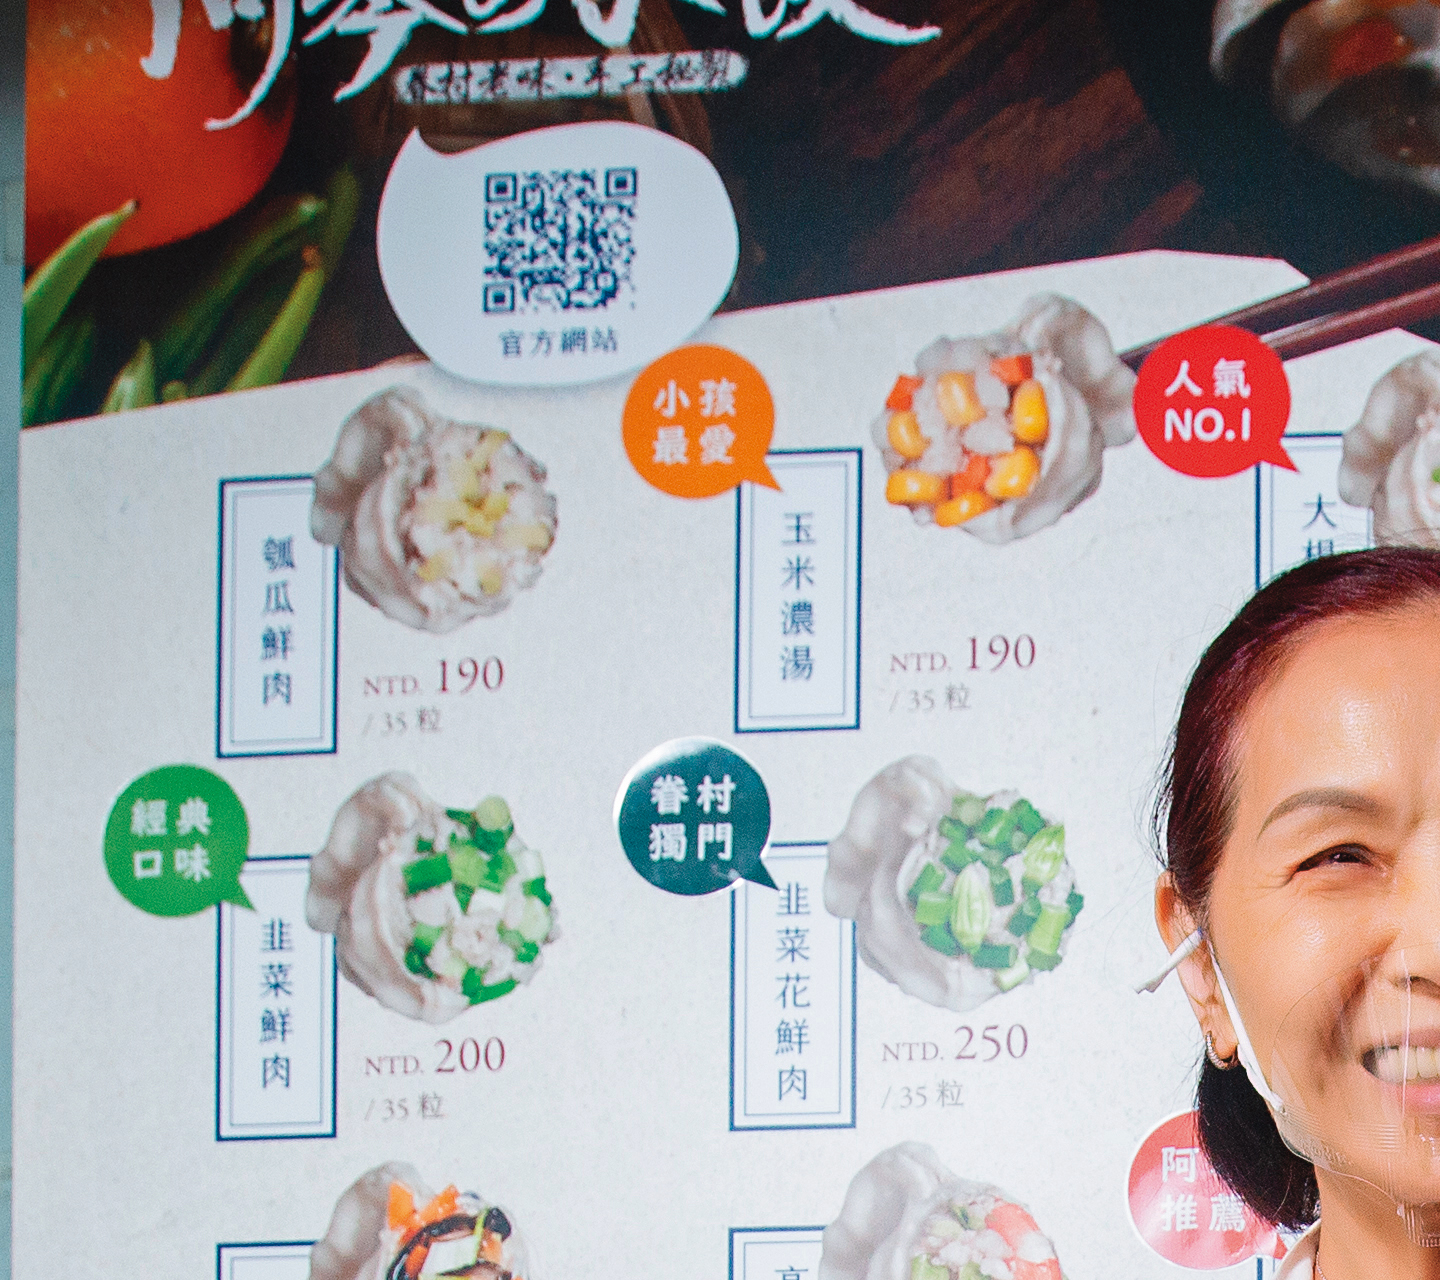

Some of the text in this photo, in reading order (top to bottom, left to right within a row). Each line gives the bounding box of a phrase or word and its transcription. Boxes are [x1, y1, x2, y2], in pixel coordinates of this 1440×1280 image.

[500, 328, 617, 357] 官方網站
[653, 379, 737, 417] 小孩
[1164, 359, 1251, 398] 人氣
[652, 427, 735, 465] 最愛
[782, 513, 814, 680] 玉米濃湯
[262, 537, 295, 704] 瓠瓜鮮肉
[890, 636, 1036, 673] NTD. 190
[364, 657, 504, 696] NTD. 190
[650, 774, 737, 815] 眷村
[130, 797, 211, 837] 經典
[649, 822, 735, 864] 獨門
[134, 849, 211, 882] 口味
[260, 919, 291, 1088] 韭菜鮮肉
[774, 881, 812, 1102] 韭菜花鮮肉
[365, 1038, 505, 1076] NTD. 200
[882, 1024, 1028, 1062] NTD. 250
[1160, 1193, 1246, 1231] 推薦
